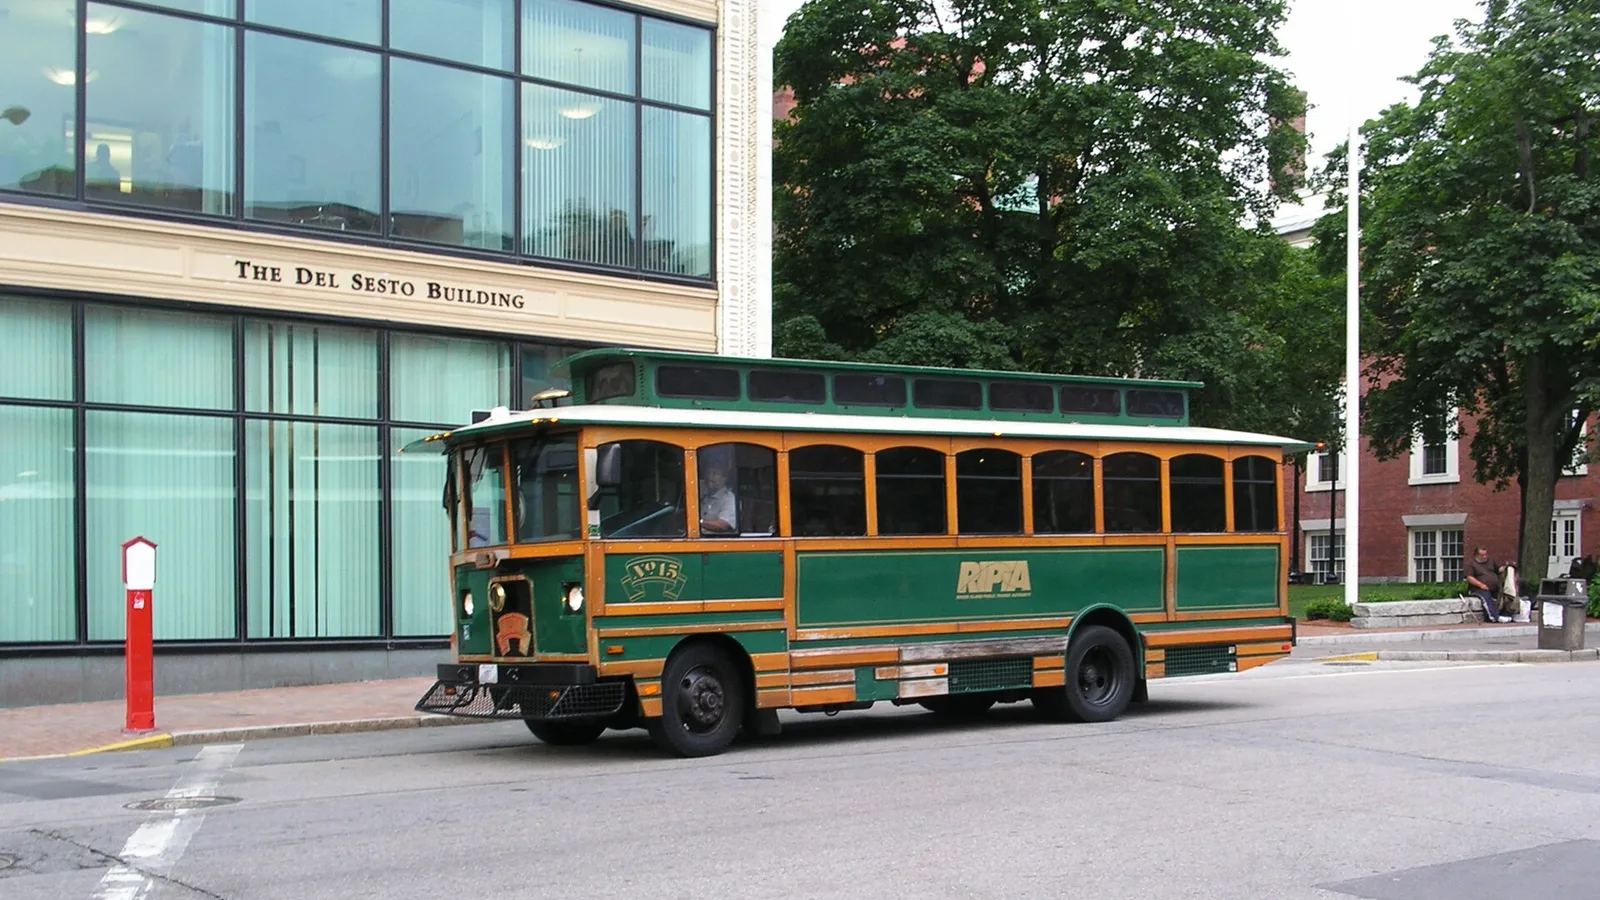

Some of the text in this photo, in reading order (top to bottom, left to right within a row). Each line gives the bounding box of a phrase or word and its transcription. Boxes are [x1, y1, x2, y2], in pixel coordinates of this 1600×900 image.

[235, 260, 525, 309] THE DEL SESTO BUILDING
